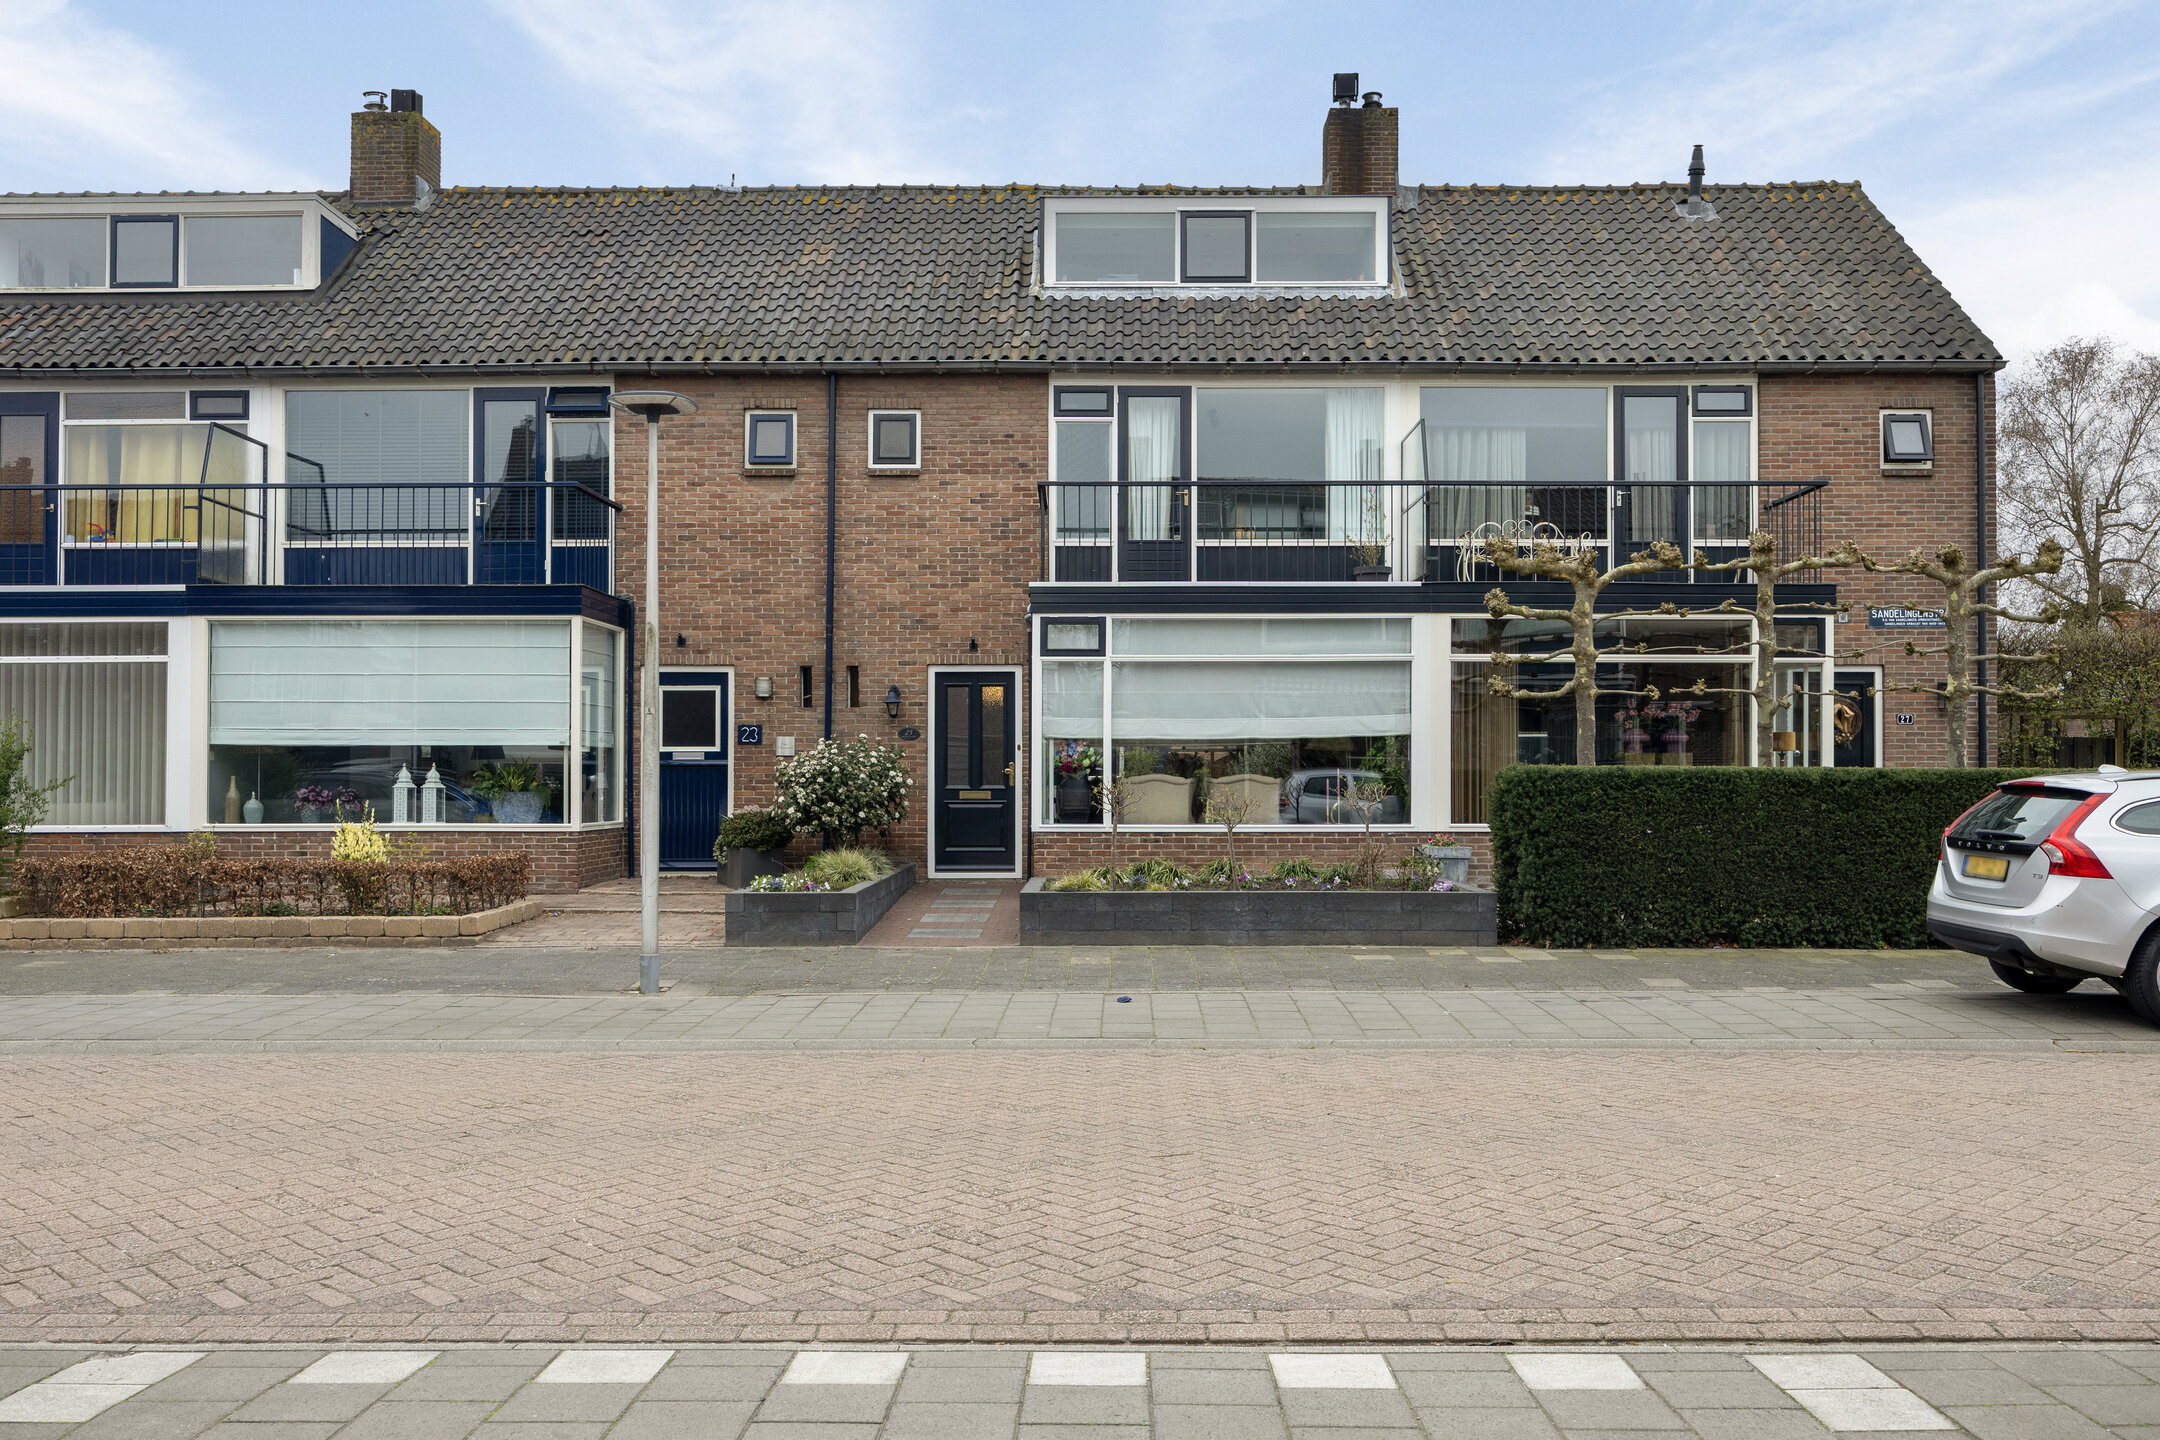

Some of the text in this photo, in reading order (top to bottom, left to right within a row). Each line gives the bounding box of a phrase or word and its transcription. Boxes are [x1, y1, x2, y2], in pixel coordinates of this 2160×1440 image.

[1900, 715, 1909, 723] 27
[741, 726, 758, 743] 23
[1958, 840, 2005, 851] VOLVO
